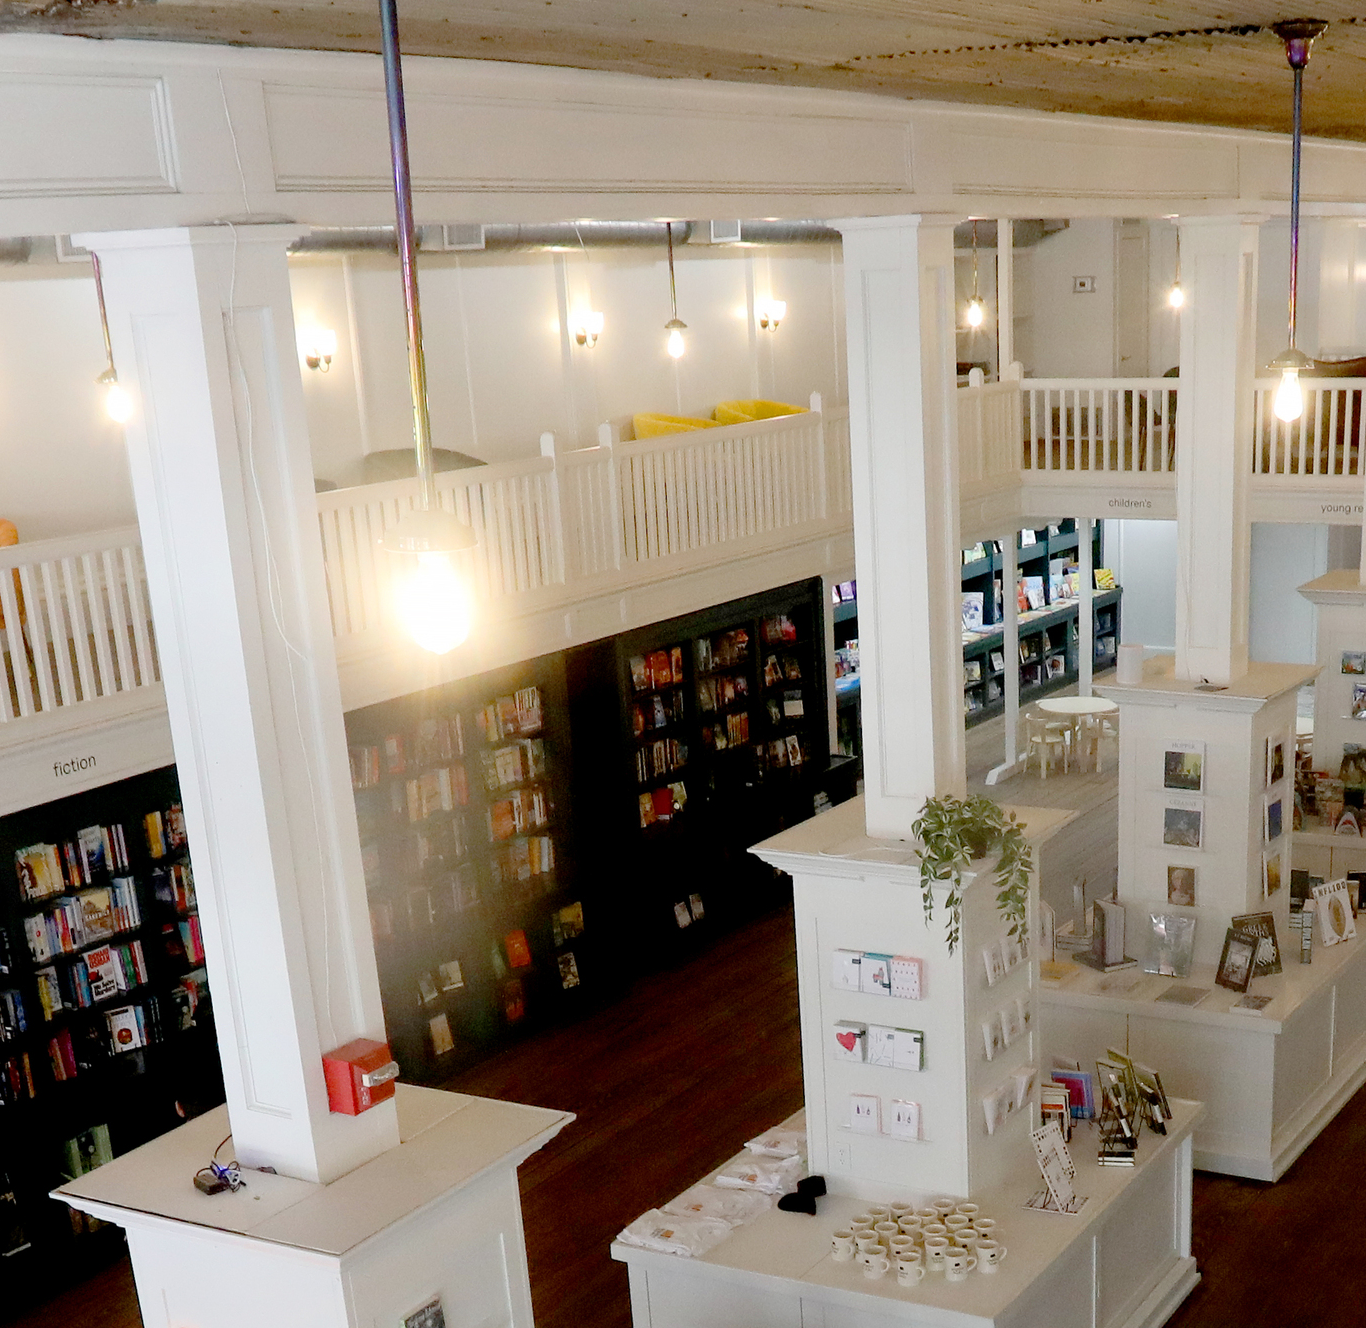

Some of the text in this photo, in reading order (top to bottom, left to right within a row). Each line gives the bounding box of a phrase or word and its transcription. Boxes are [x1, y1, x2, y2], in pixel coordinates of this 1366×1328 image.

[1108, 498, 1152, 508] children's
[1321, 504, 1351, 515] young
[53, 755, 97, 777] fiction
